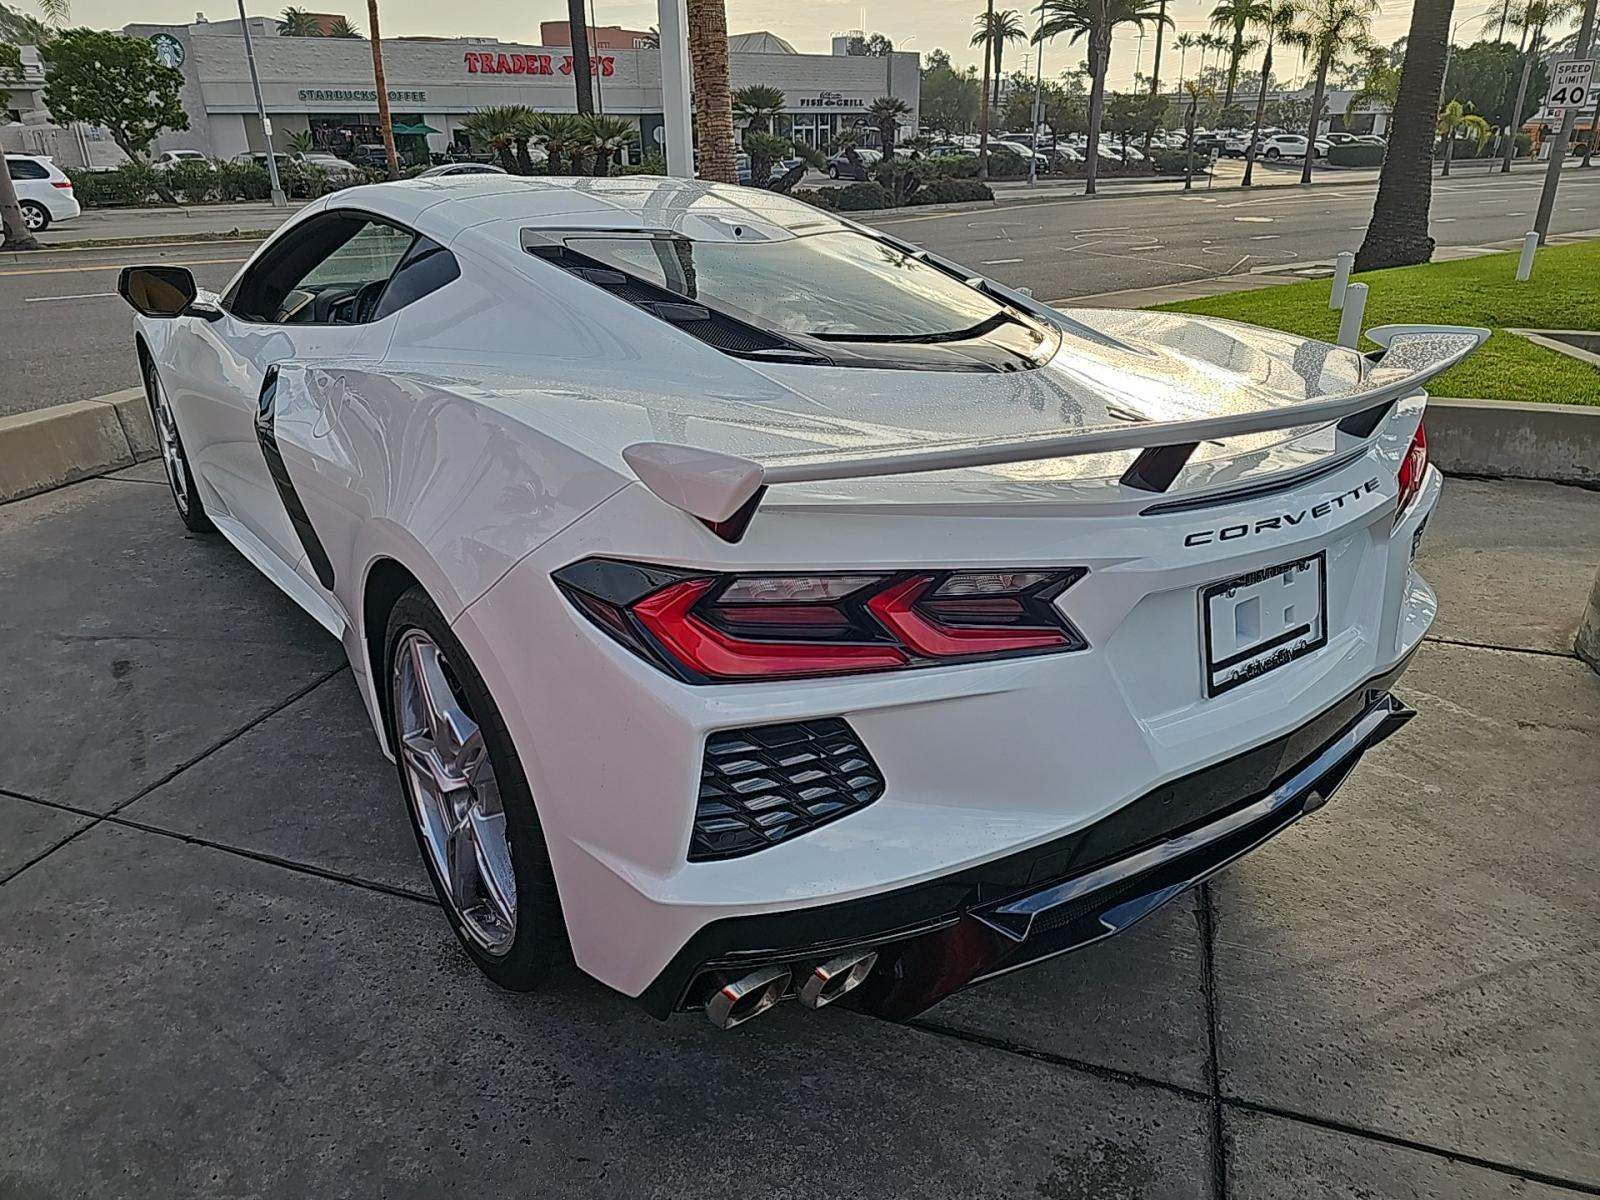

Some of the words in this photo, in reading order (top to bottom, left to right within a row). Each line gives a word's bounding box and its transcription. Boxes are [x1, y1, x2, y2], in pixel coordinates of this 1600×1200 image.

[464, 53, 554, 75] TRADER
[558, 56, 615, 77] JE'S
[1558, 65, 1591, 73] SPEED
[1558, 76, 1585, 84] LIMIT
[298, 89, 377, 100] STARBUCKS
[387, 91, 427, 101] OFFEE
[1551, 87, 1585, 104] 40
[800, 98, 823, 107] FISH
[836, 99, 864, 107] GRILL
[1184, 476, 1381, 548] CORVETTE
